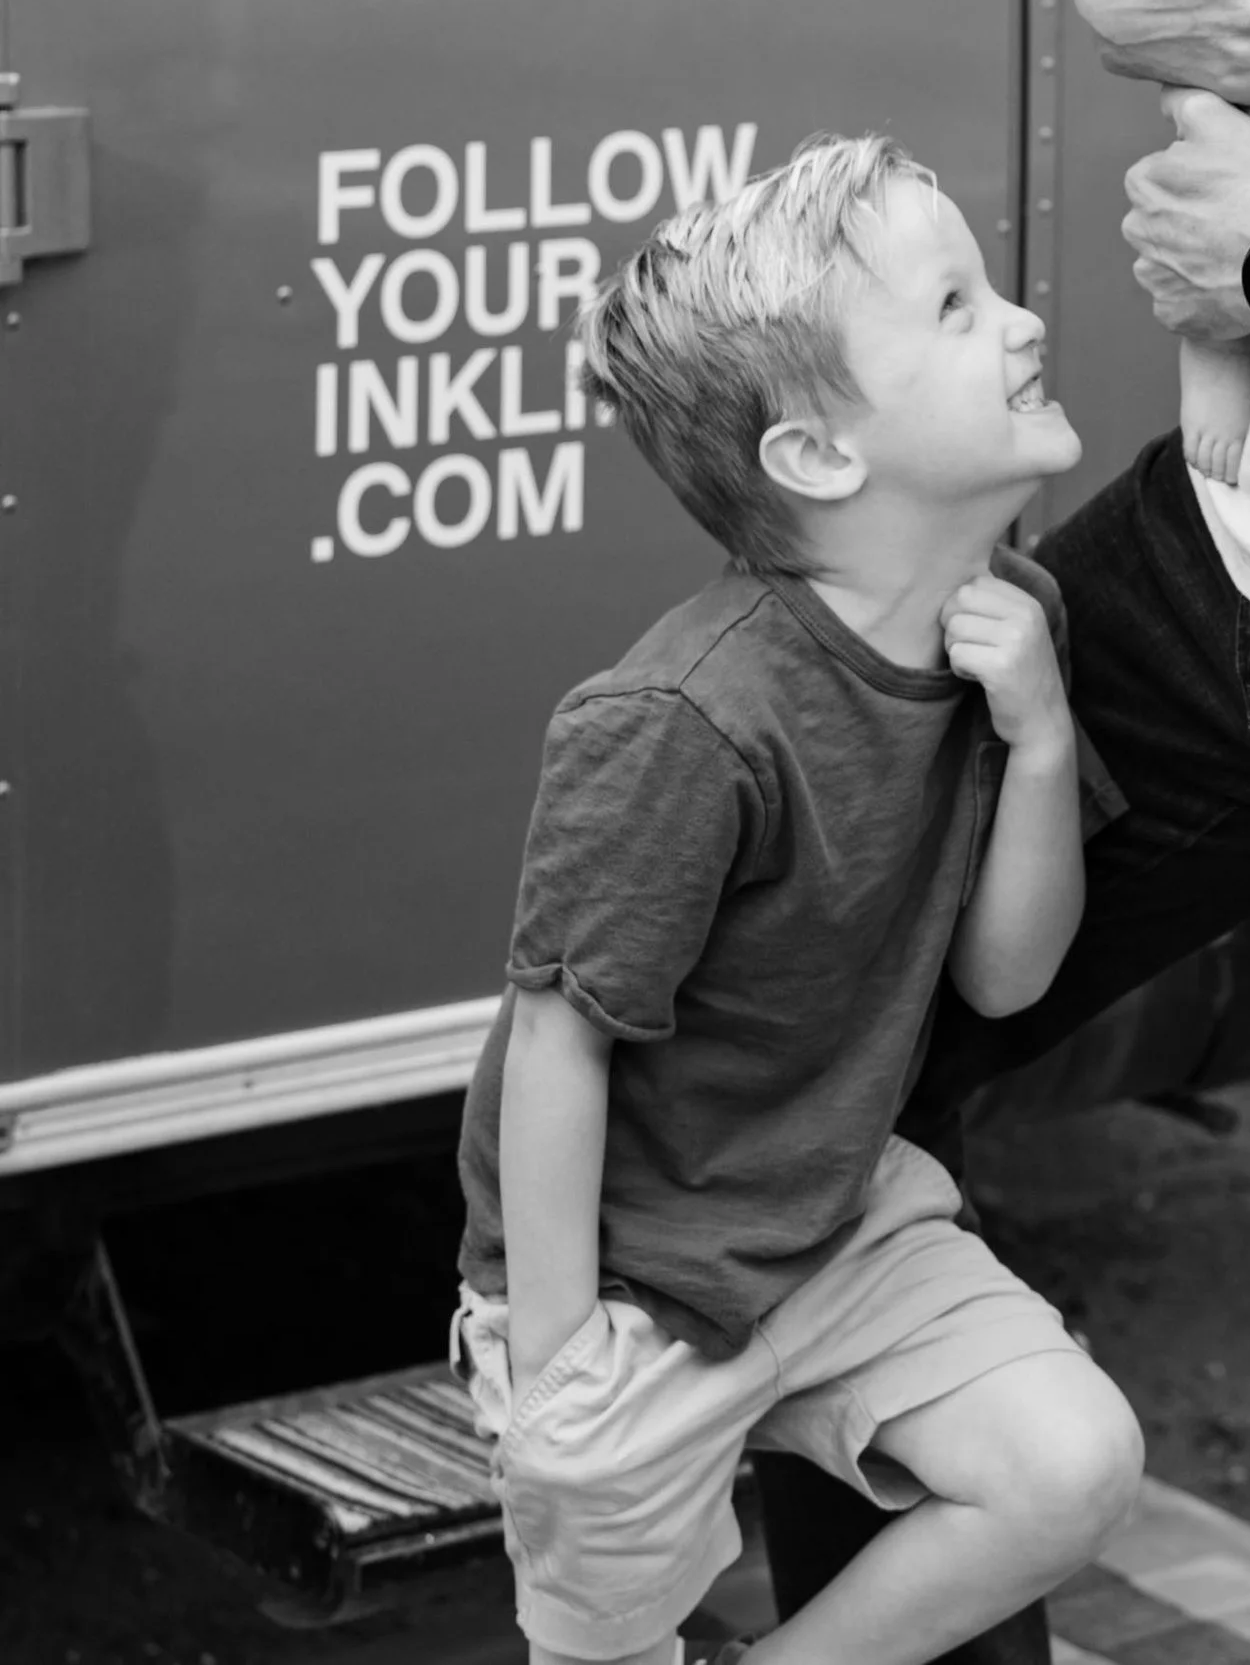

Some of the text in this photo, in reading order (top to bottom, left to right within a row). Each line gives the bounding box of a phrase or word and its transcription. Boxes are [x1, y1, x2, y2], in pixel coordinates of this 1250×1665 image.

[317, 121, 758, 245] FOLLOW
[311, 237, 602, 350] YOUR
[315, 338, 616, 457] INKLI
[311, 441, 585, 562] .COM
